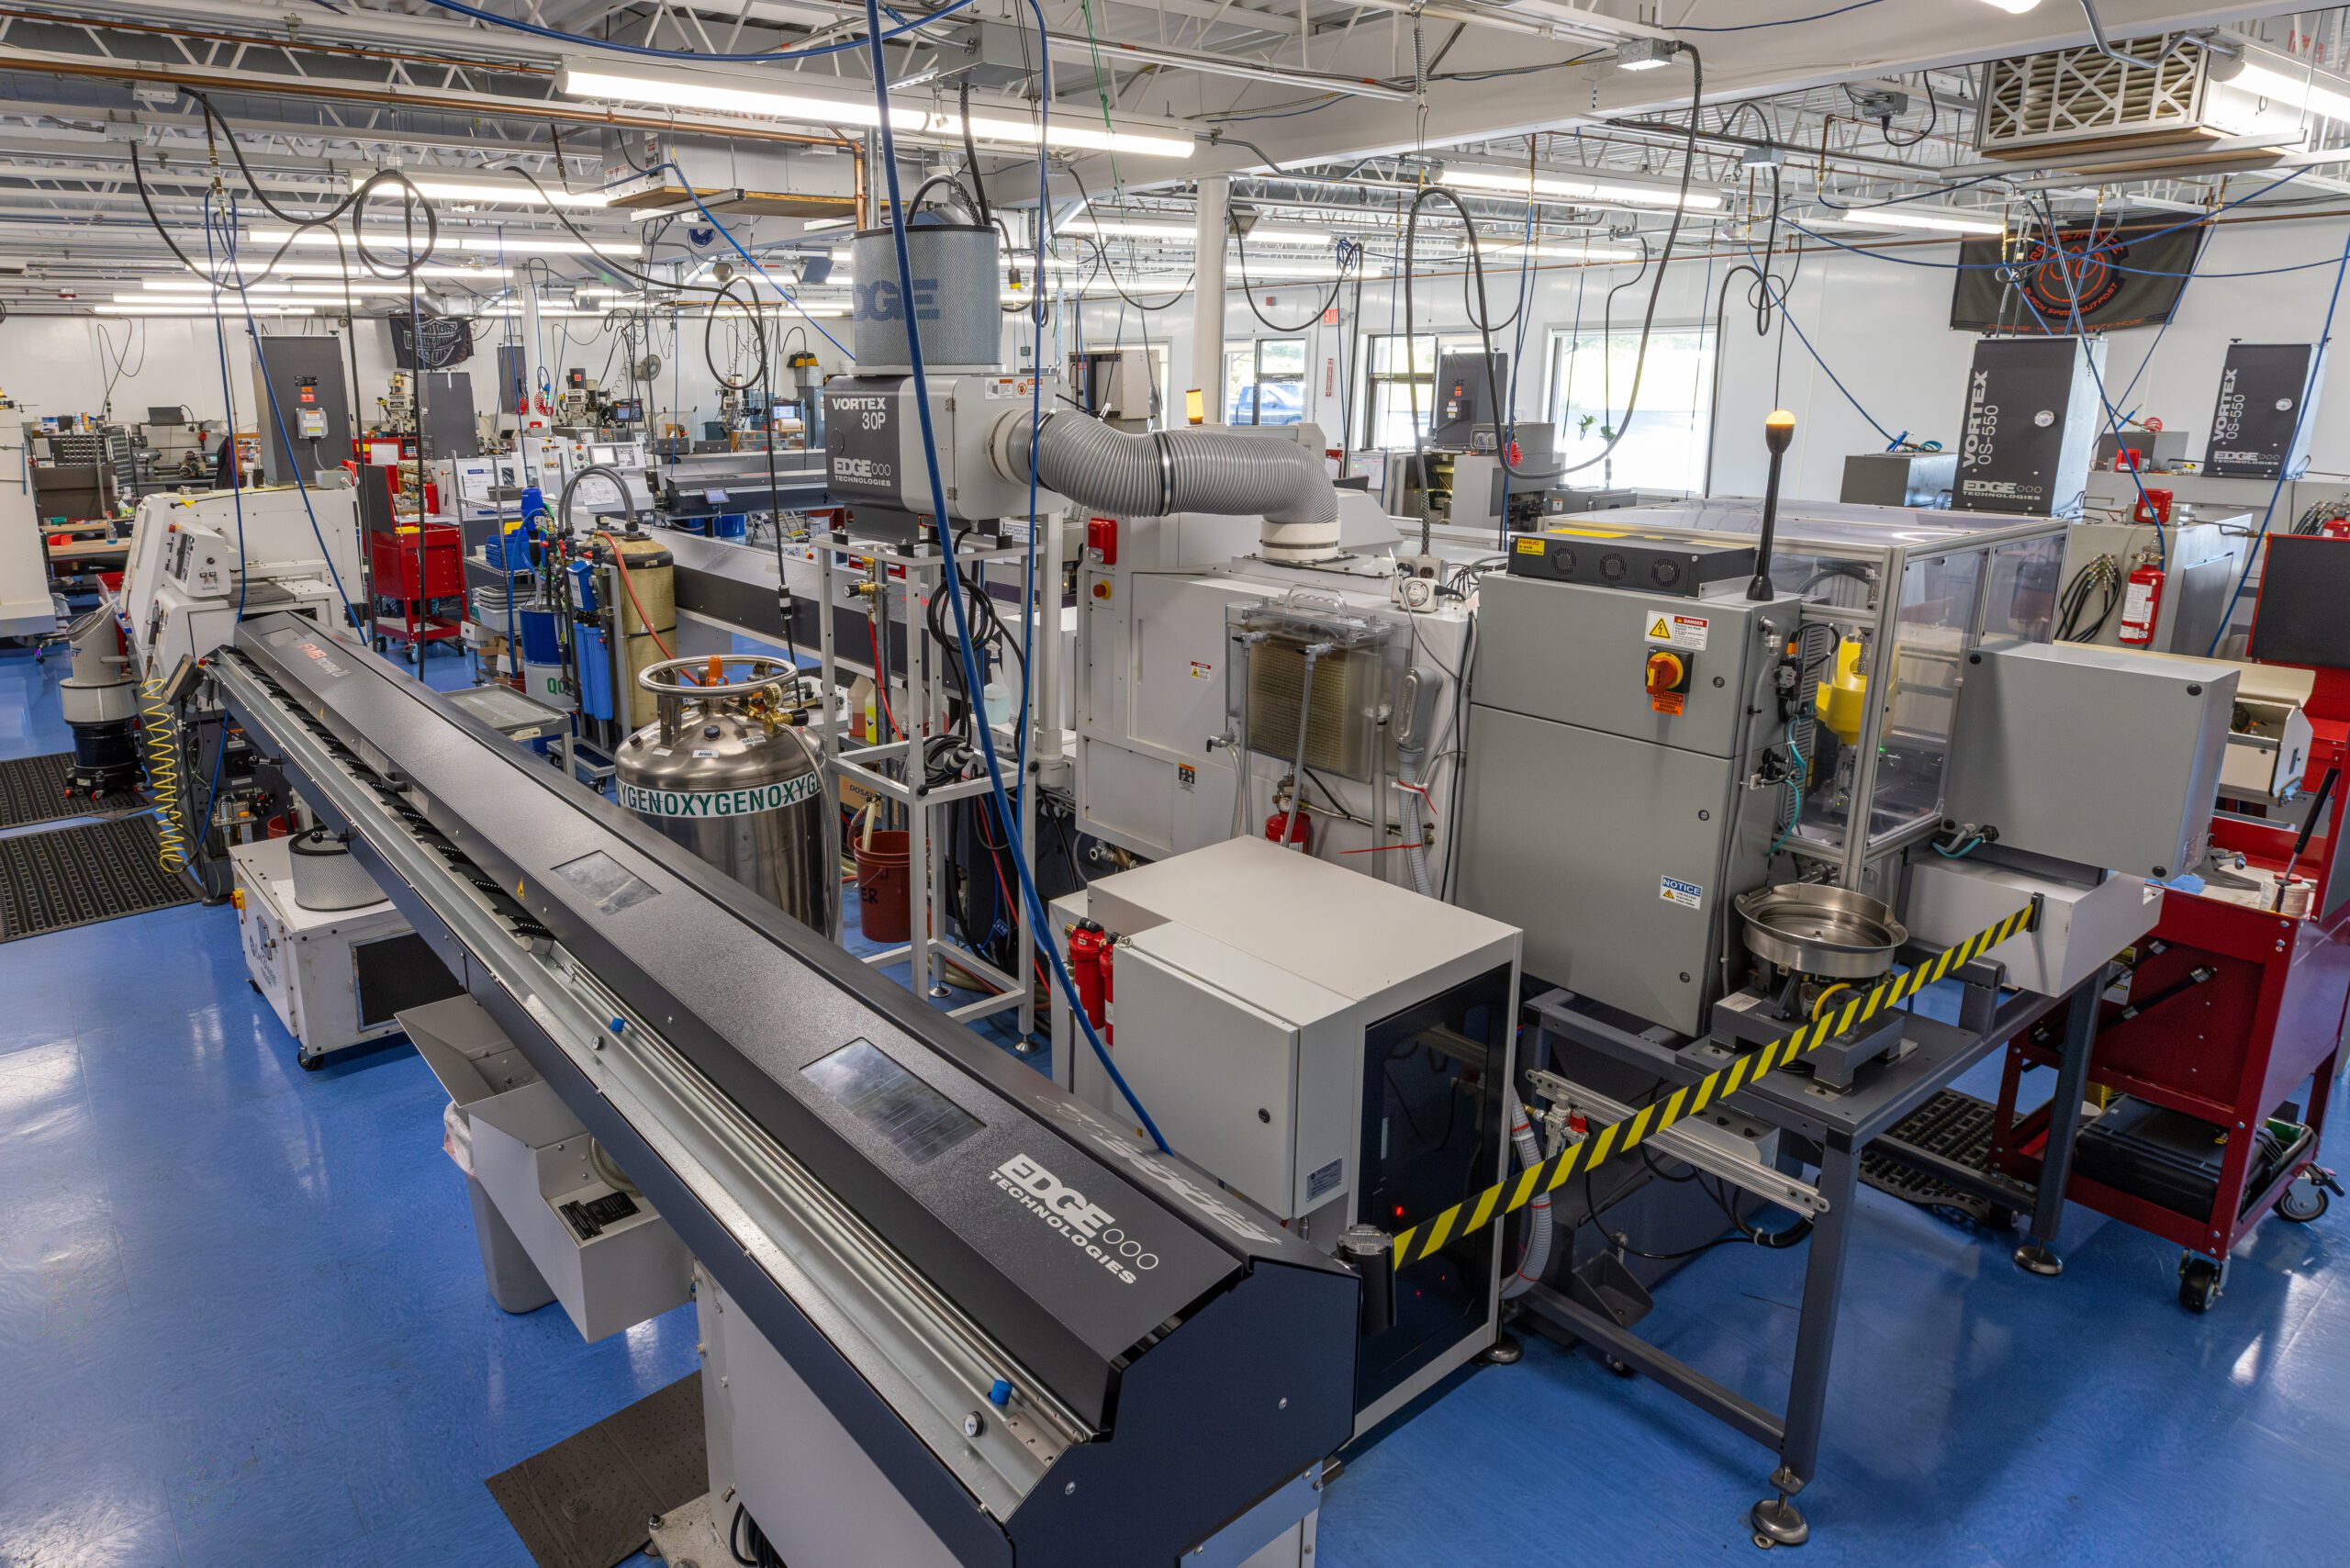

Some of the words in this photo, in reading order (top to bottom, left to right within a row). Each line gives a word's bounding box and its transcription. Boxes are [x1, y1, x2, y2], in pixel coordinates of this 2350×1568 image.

[1324, 308, 1338, 323] EXIT
[832, 398, 887, 410] VORTEX
[2213, 368, 2238, 441] VORTEX
[862, 412, 886, 430] 30P
[1963, 370, 1988, 467] VORTEX
[2213, 451, 2258, 461] EDGE
[834, 457, 871, 477] EDGE
[834, 476, 890, 487] TECHNOLOGIES
[1963, 479, 2017, 494] EDGE
[1962, 490, 2042, 500] TECHNOLOGIES
[1683, 618, 1705, 626] DANGER
[1662, 878, 1701, 896] NOTICE
[998, 1153, 1115, 1238] EDGE
[989, 1170, 1136, 1283] TECHNOLOGIES
